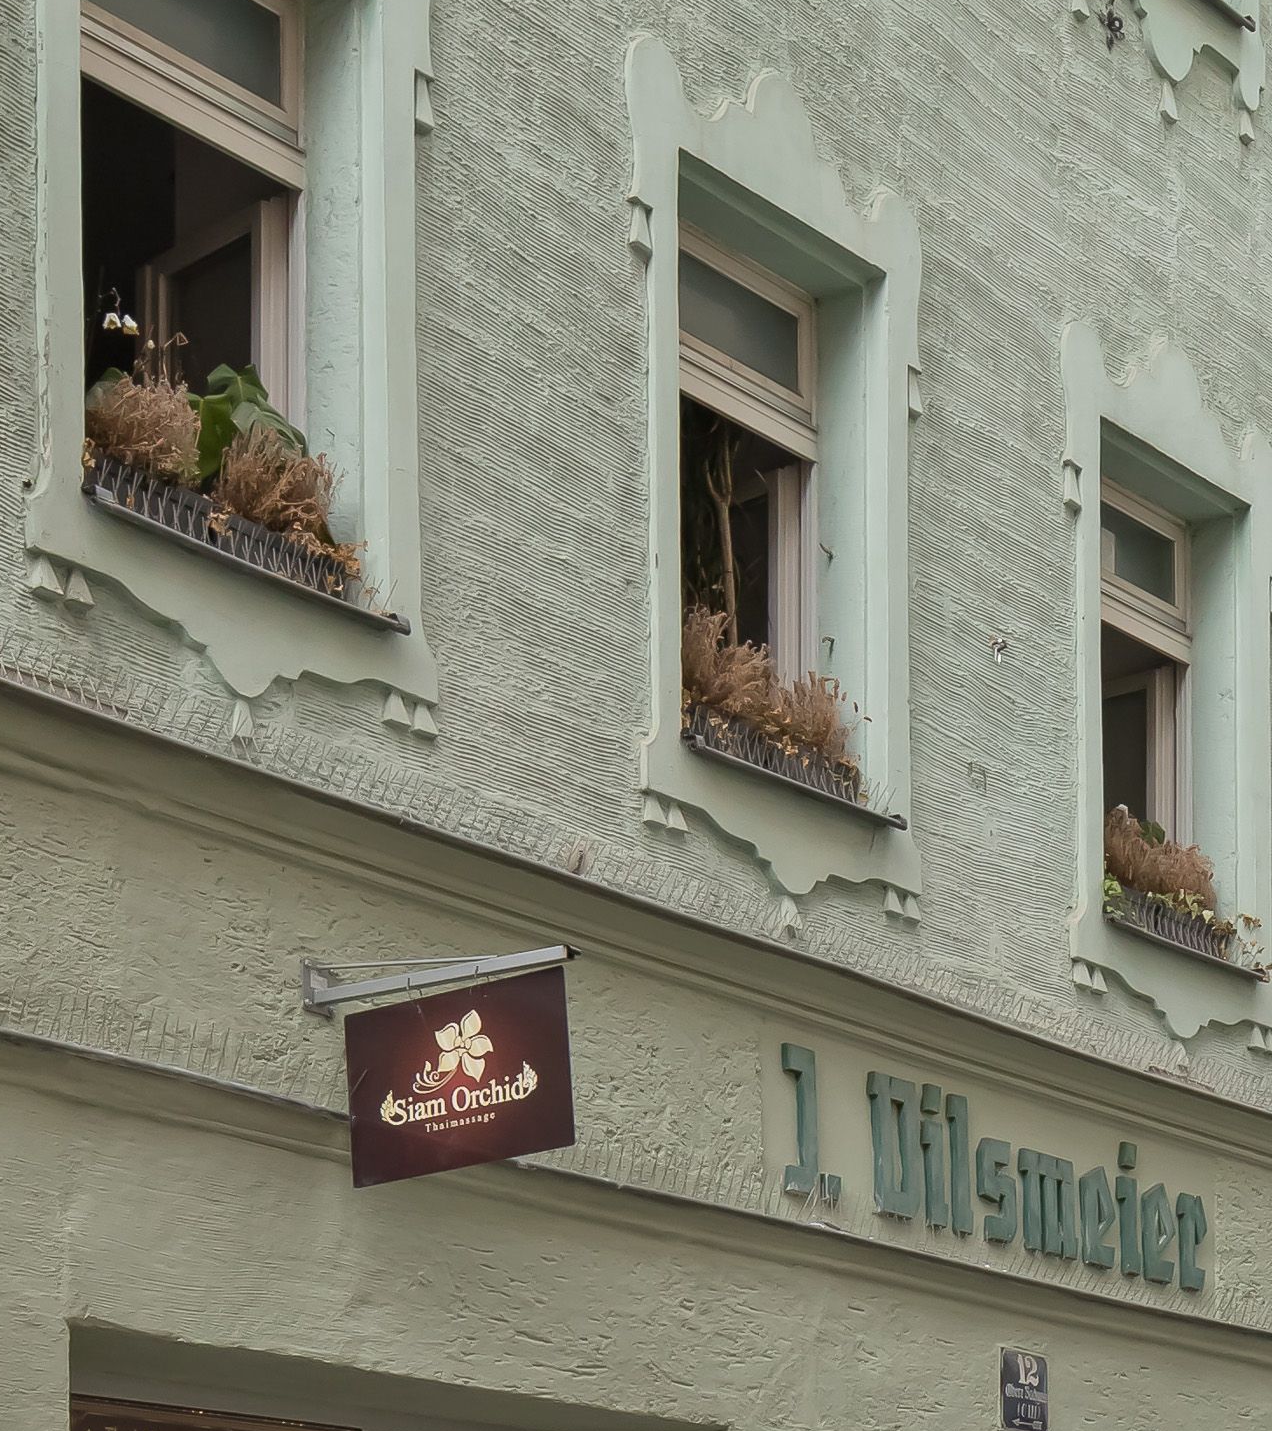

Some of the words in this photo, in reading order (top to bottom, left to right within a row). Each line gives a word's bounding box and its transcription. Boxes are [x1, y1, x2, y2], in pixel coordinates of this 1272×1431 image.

[385, 1096, 448, 1126] Siam
[451, 1073, 529, 1112] Orchid
[425, 1112, 496, 1133] Thaimassage
[1017, 1354, 1040, 1387] 12
